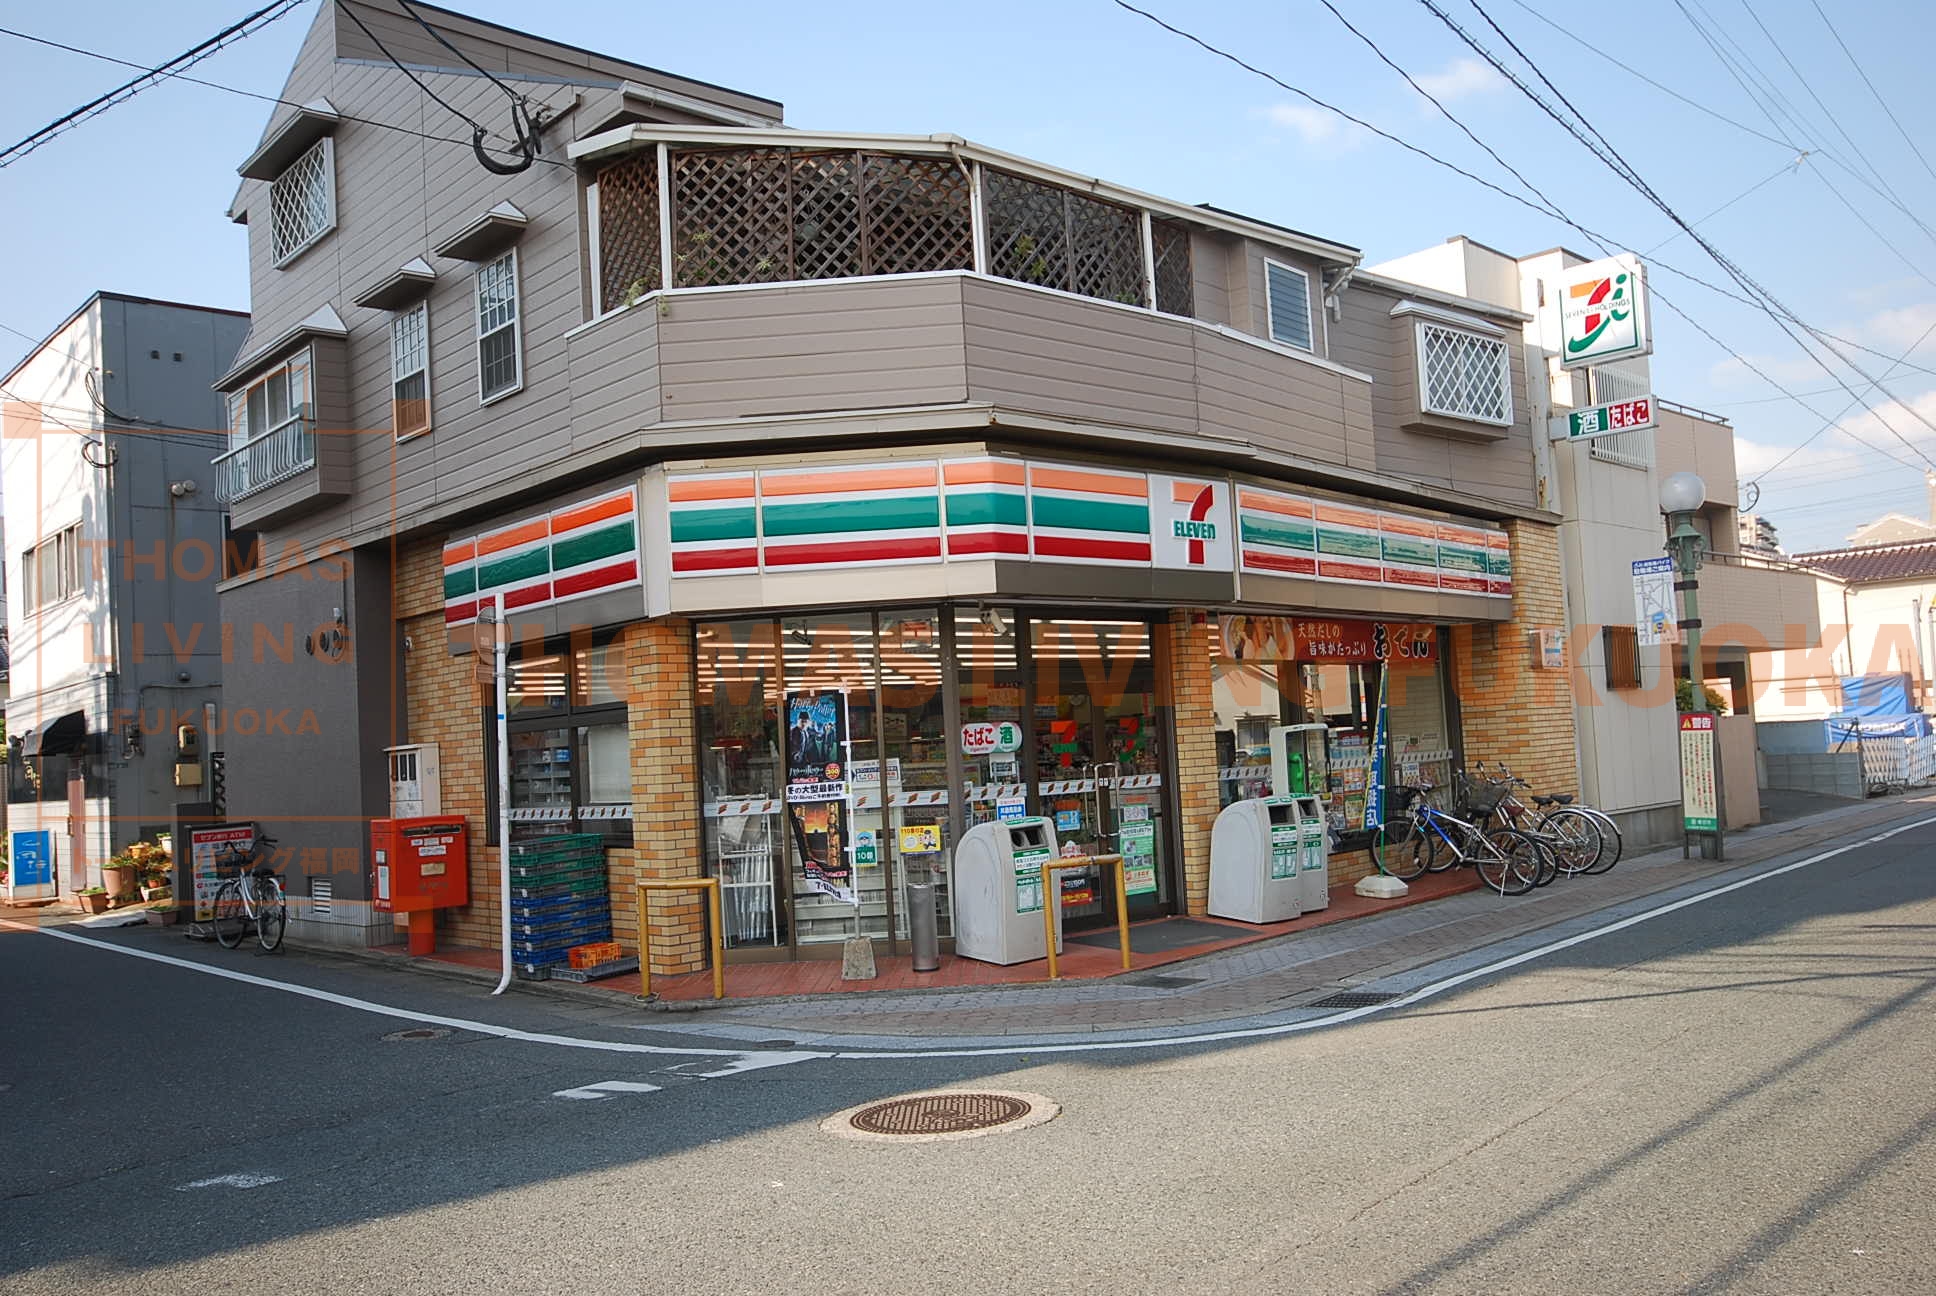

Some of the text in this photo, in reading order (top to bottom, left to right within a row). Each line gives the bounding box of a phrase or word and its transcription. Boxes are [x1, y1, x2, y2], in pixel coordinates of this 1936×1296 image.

[1577, 401, 1648, 435] 酒 たばこ
[1298, 622, 1341, 639] 天然だしの
[1309, 639, 1367, 656] 旨味がたっぷり
[963, 726, 1014, 746] たばこ 酒
